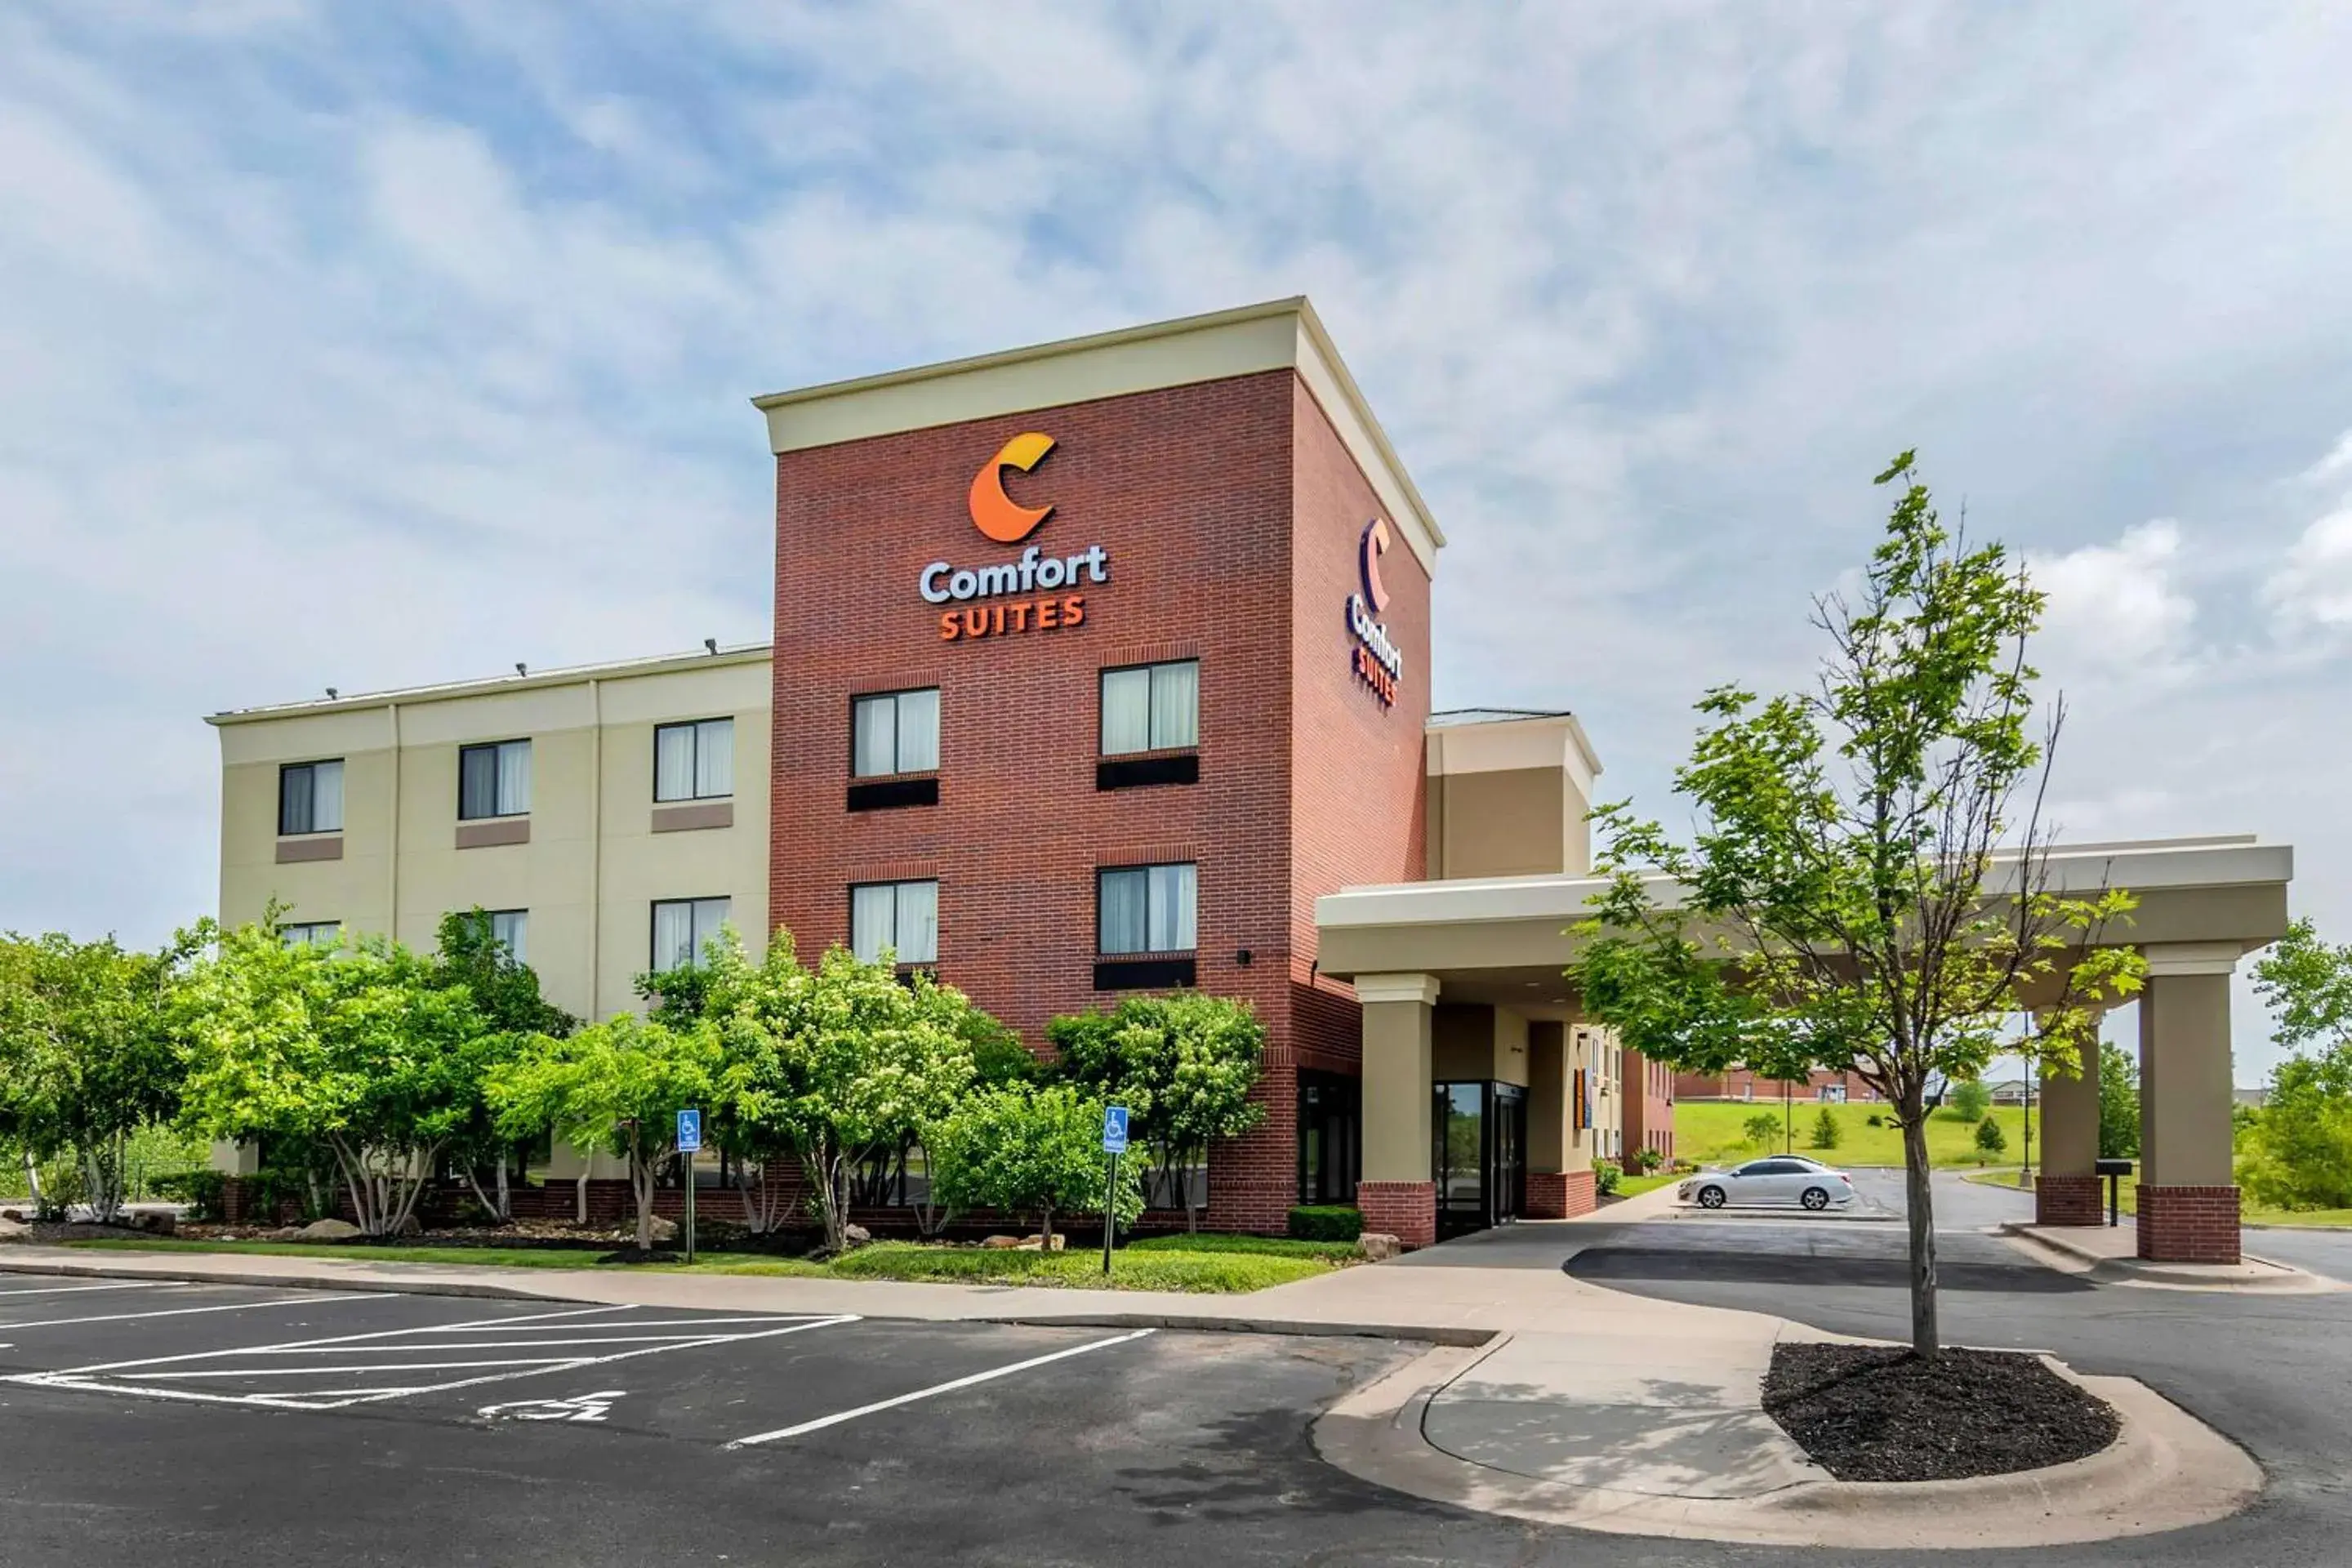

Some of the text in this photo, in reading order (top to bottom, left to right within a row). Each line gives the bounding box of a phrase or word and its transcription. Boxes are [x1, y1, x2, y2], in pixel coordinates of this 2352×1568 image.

[920, 545, 1107, 603] Comfort
[941, 595, 1085, 639] SUITES
[1350, 593, 1402, 681] Comfort
[1356, 645, 1397, 707] SUITES
